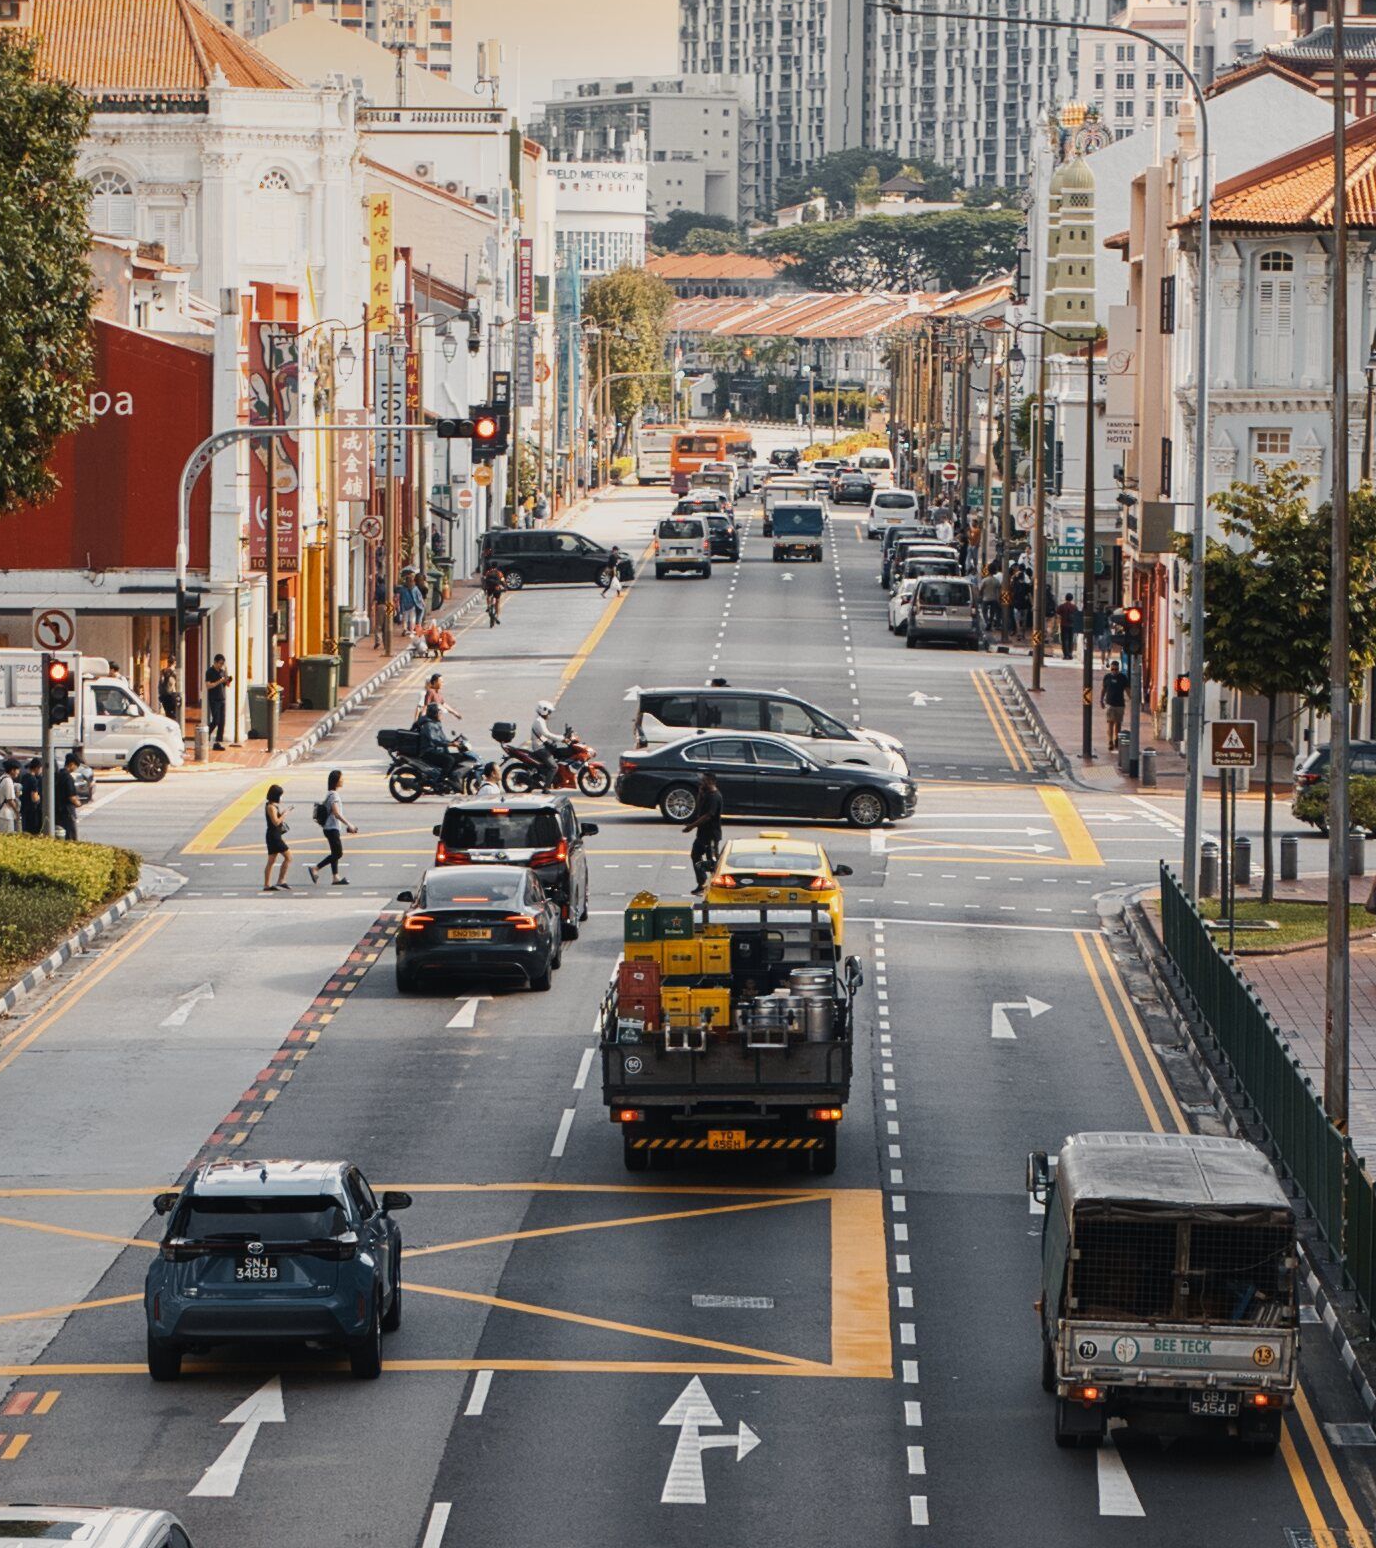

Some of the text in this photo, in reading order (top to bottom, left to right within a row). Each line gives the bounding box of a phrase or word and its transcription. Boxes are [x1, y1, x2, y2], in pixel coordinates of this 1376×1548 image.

[373, 200, 389, 324] 北京同仁堂
[1106, 436, 1132, 444] HOTEL
[244, 1257, 269, 1268] SNJ
[236, 1267, 278, 1279] 3483B
[1083, 1343, 1094, 1355] 70
[1154, 1338, 1212, 1354] BEE TECK
[1257, 1349, 1272, 1359] 13
[1201, 1391, 1227, 1402] GBJ
